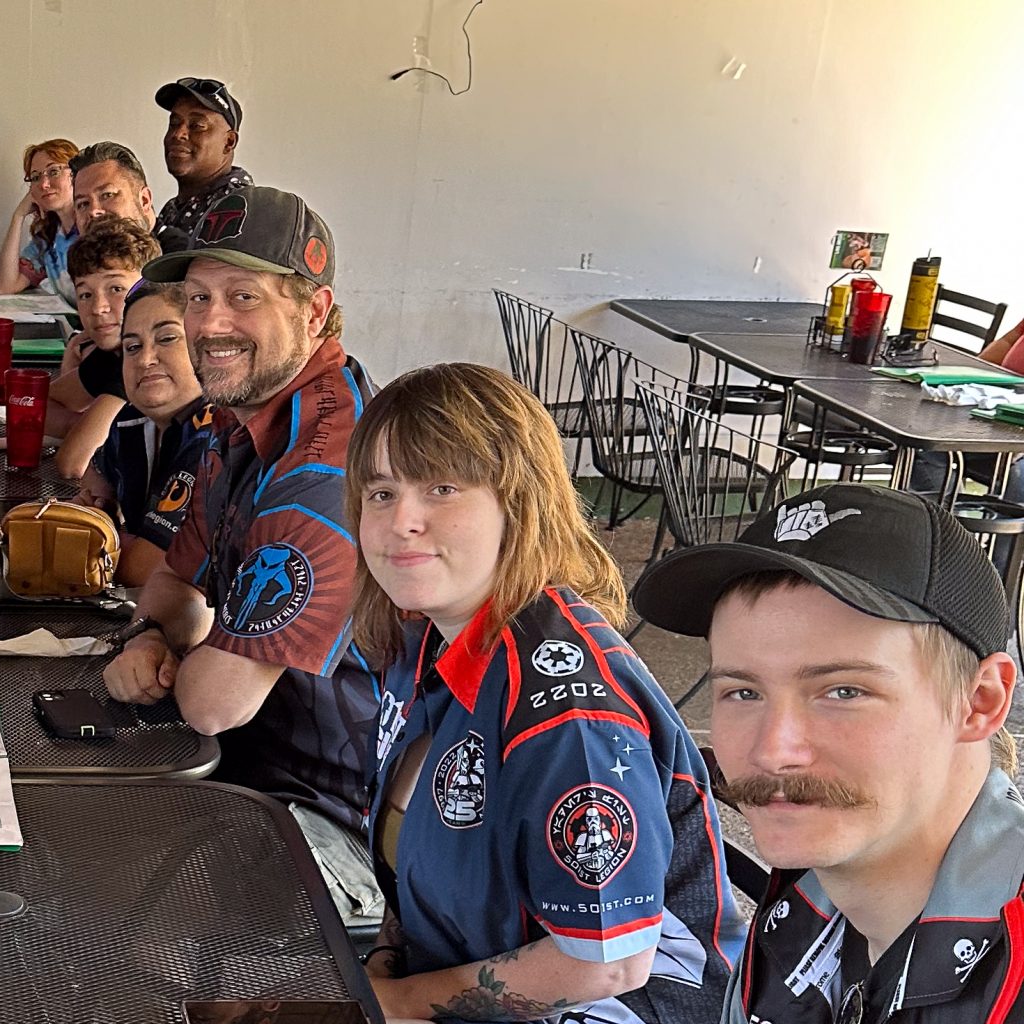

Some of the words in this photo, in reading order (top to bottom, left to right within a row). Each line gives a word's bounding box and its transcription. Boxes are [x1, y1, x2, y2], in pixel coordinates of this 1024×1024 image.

[438, 752, 457, 779] 2022
[443, 800, 477, 821] 25
[563, 854, 591, 881] 501ST
[595, 847, 628, 883] LEGION
